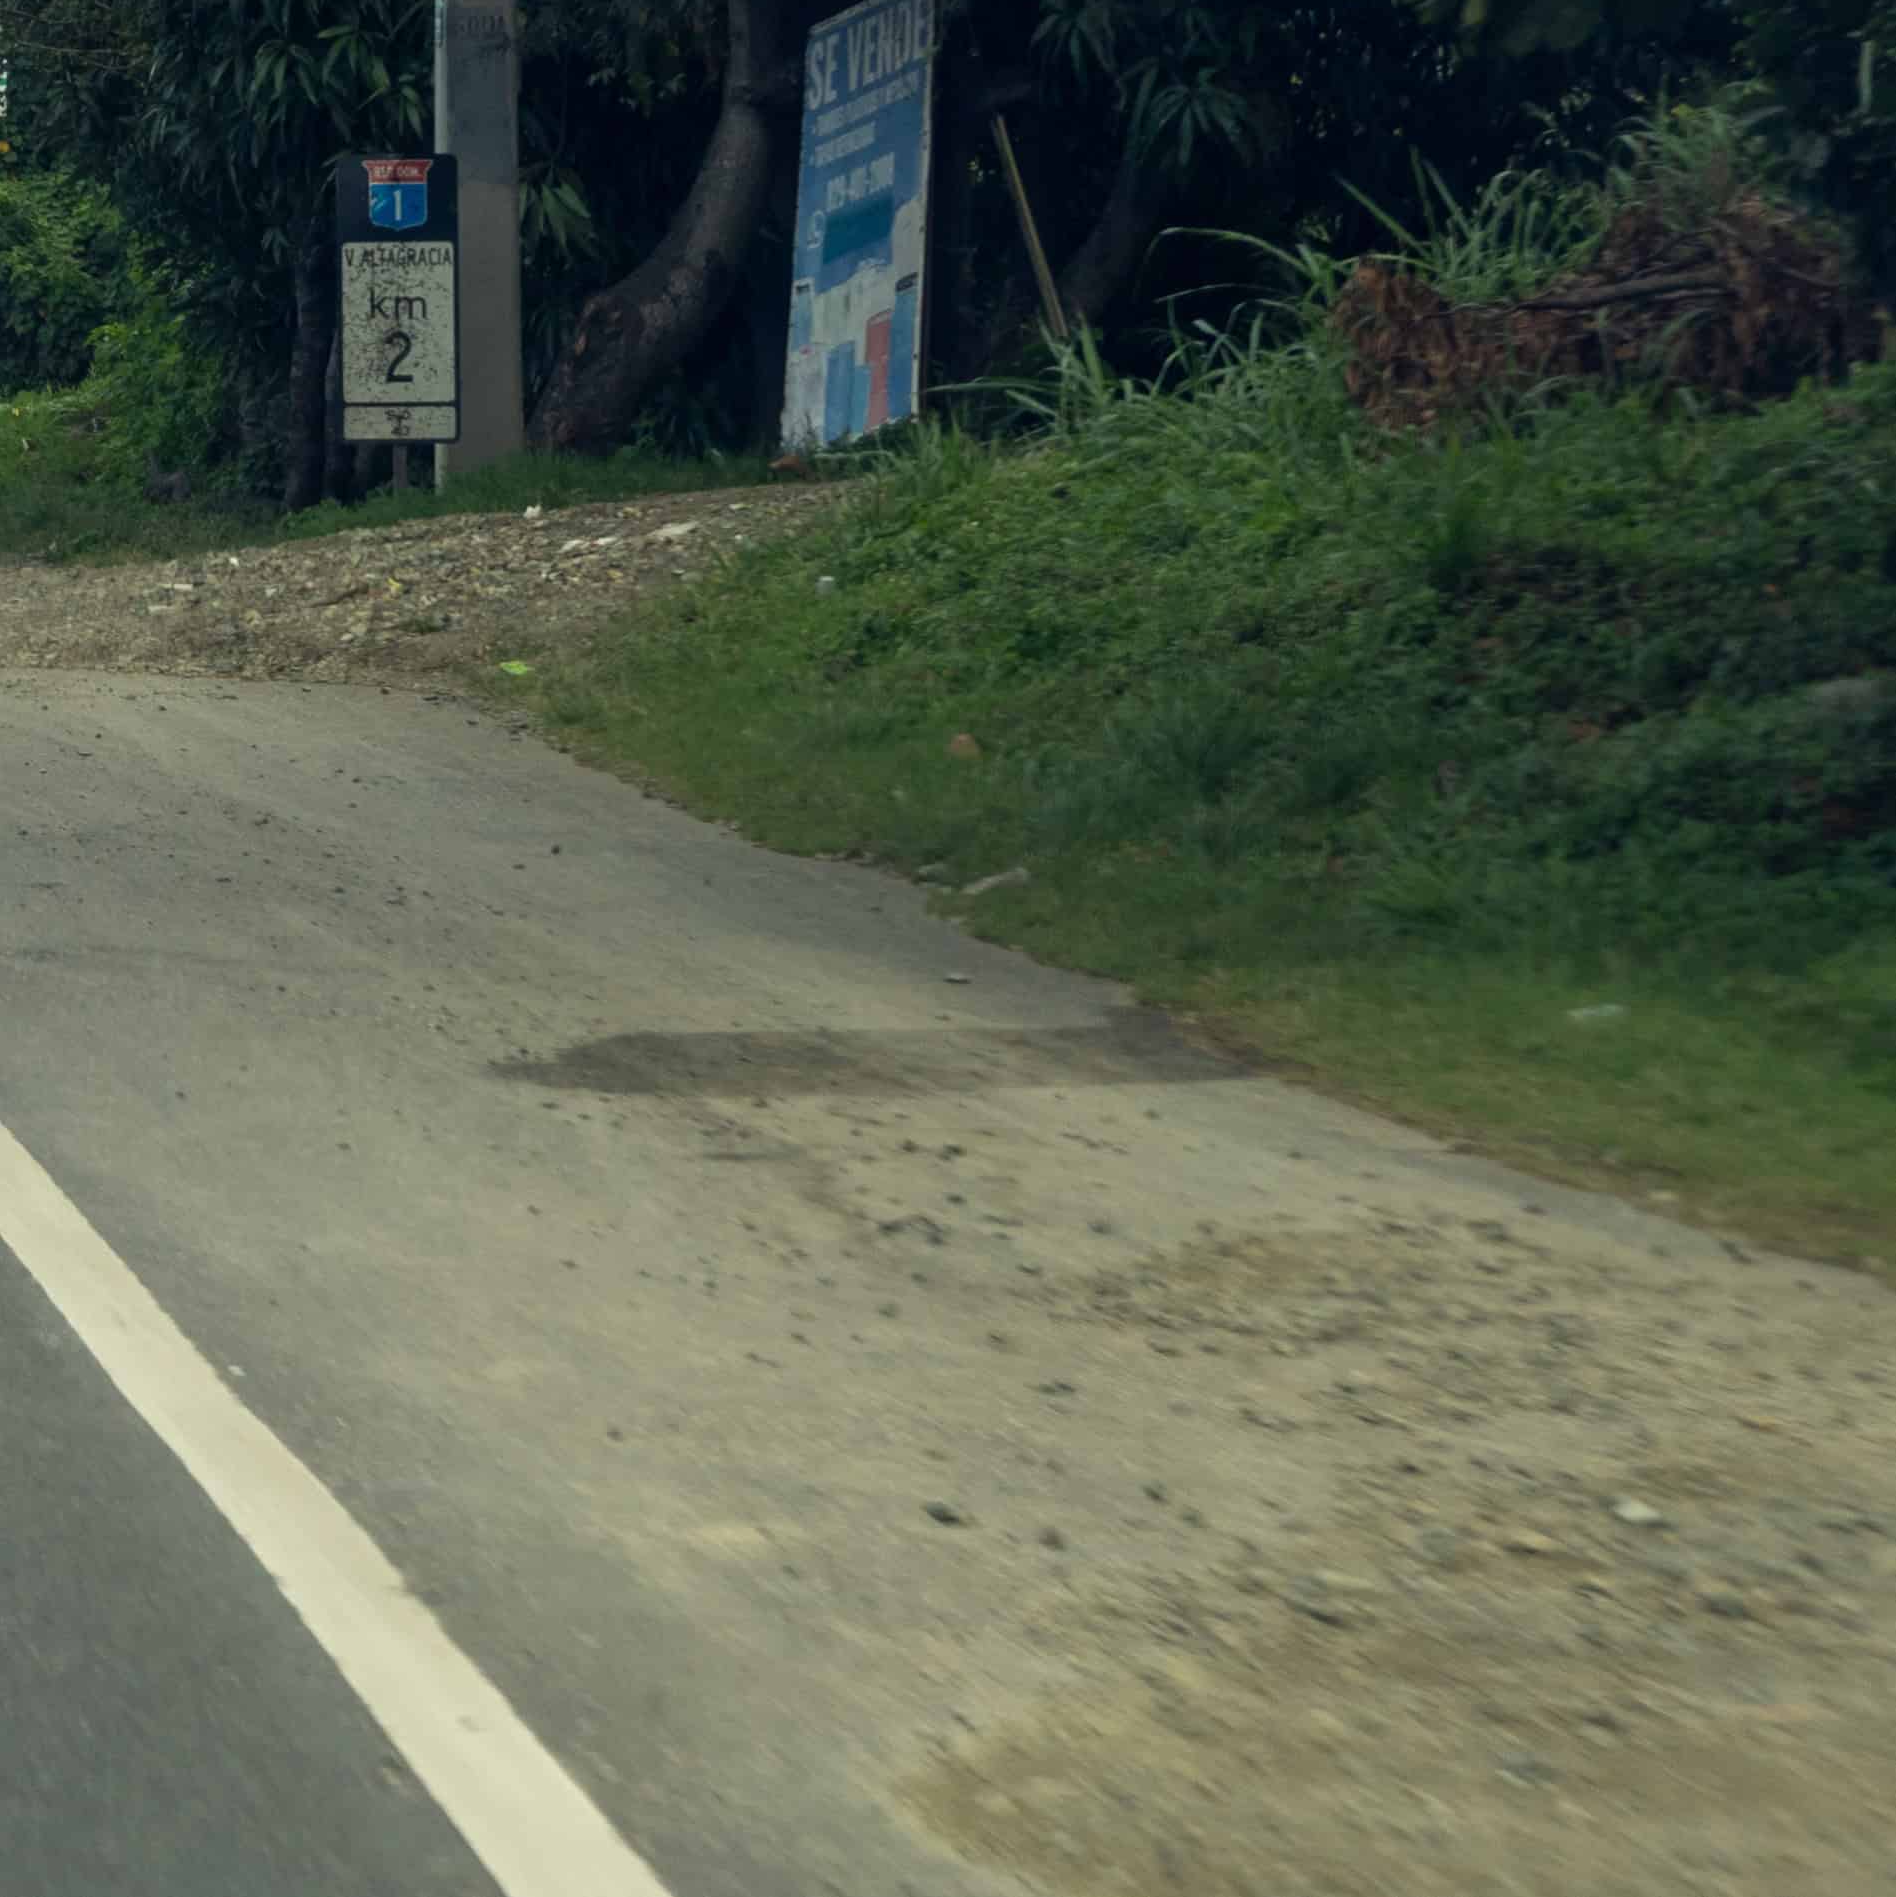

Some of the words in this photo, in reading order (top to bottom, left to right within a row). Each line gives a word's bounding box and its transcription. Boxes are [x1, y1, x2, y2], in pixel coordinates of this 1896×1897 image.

[805, 33, 840, 111] SE
[393, 189, 403, 221] 1
[360, 247, 452, 266] ALTAGRACIA
[367, 286, 429, 320] km
[384, 331, 414, 383] 2
